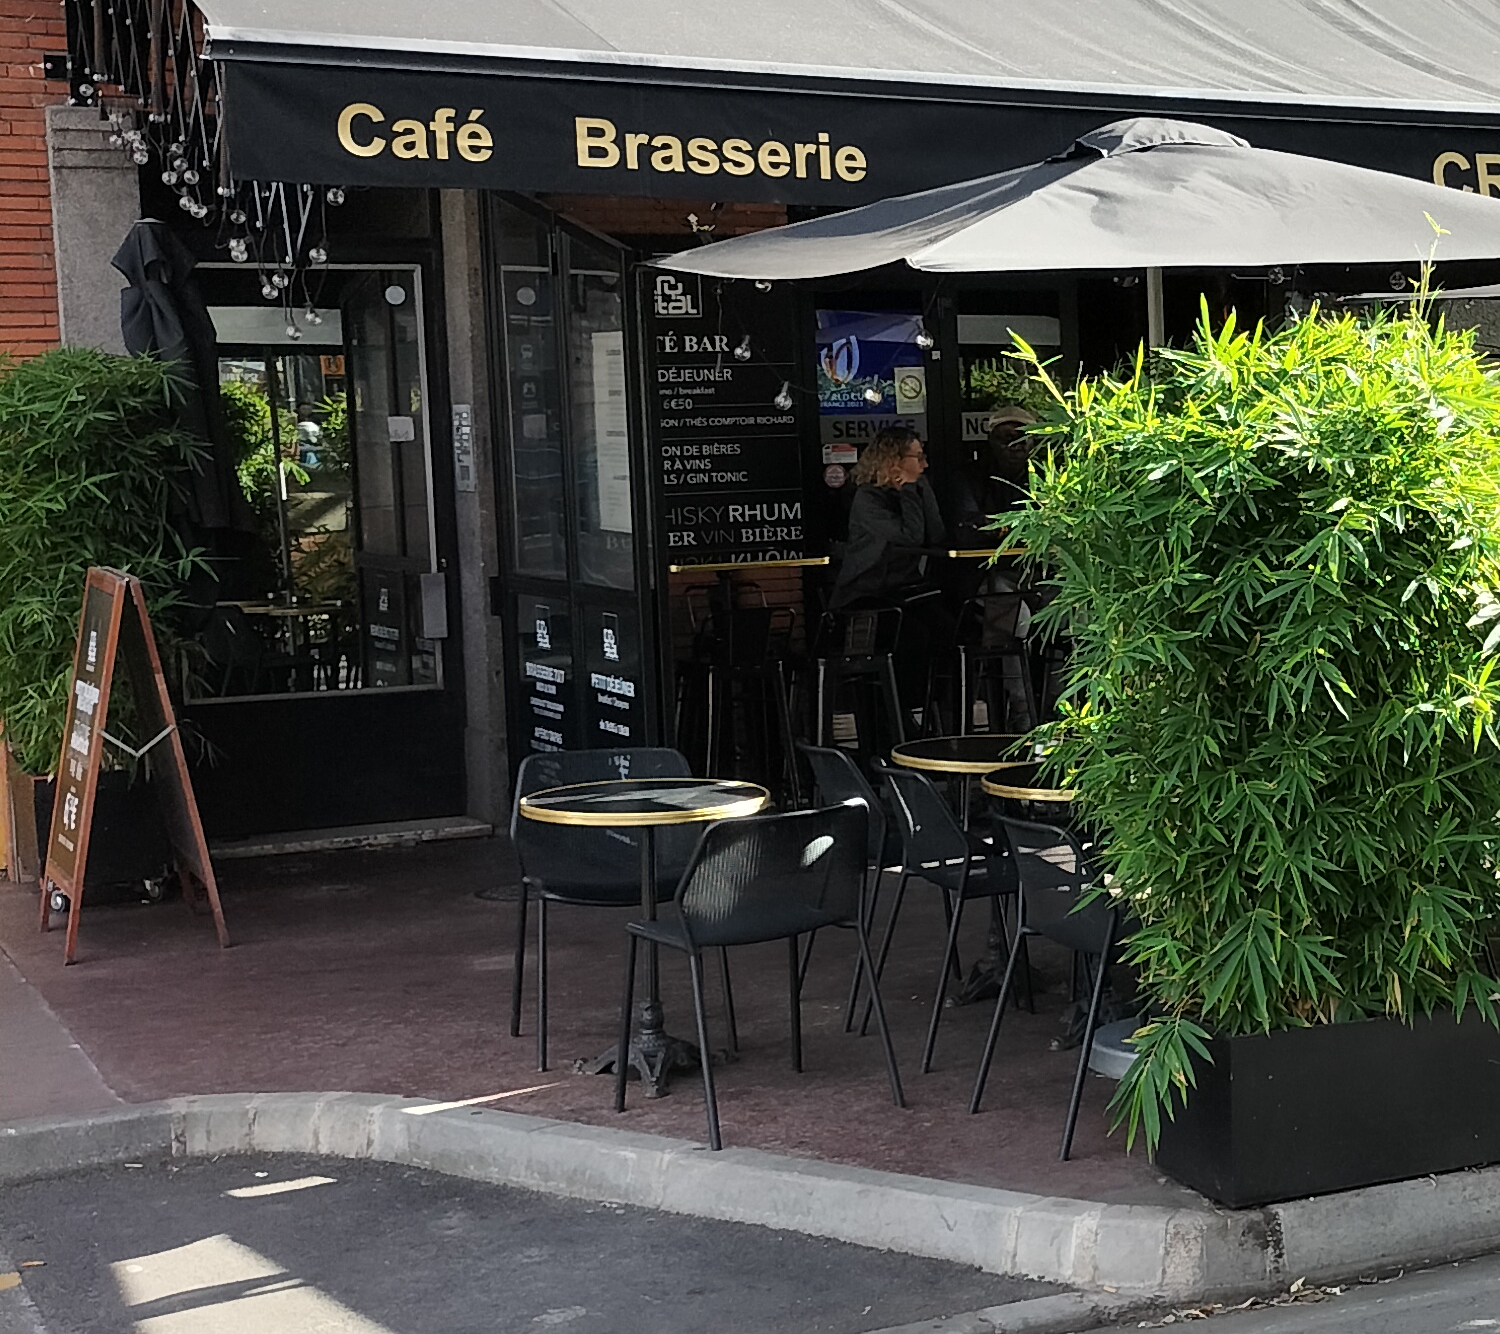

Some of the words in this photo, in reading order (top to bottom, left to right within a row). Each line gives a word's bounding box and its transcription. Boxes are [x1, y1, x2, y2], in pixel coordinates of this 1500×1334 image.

[337, 102, 494, 163] Café
[574, 117, 868, 183] Brasserie
[684, 336, 730, 352] BAR
[657, 367, 733, 383] DÉJEUNER
[709, 416, 755, 427] COMPTOIR
[756, 416, 795, 425] RICHARD
[683, 445, 700, 456] DE
[702, 442, 741, 455] BIÈRES
[684, 459, 712, 469] VINS
[686, 473, 709, 484] GIN
[712, 472, 748, 483] TONIC
[728, 502, 802, 523] RHUM
[701, 529, 735, 545] VIN
[740, 525, 804, 544] BIÈRE
